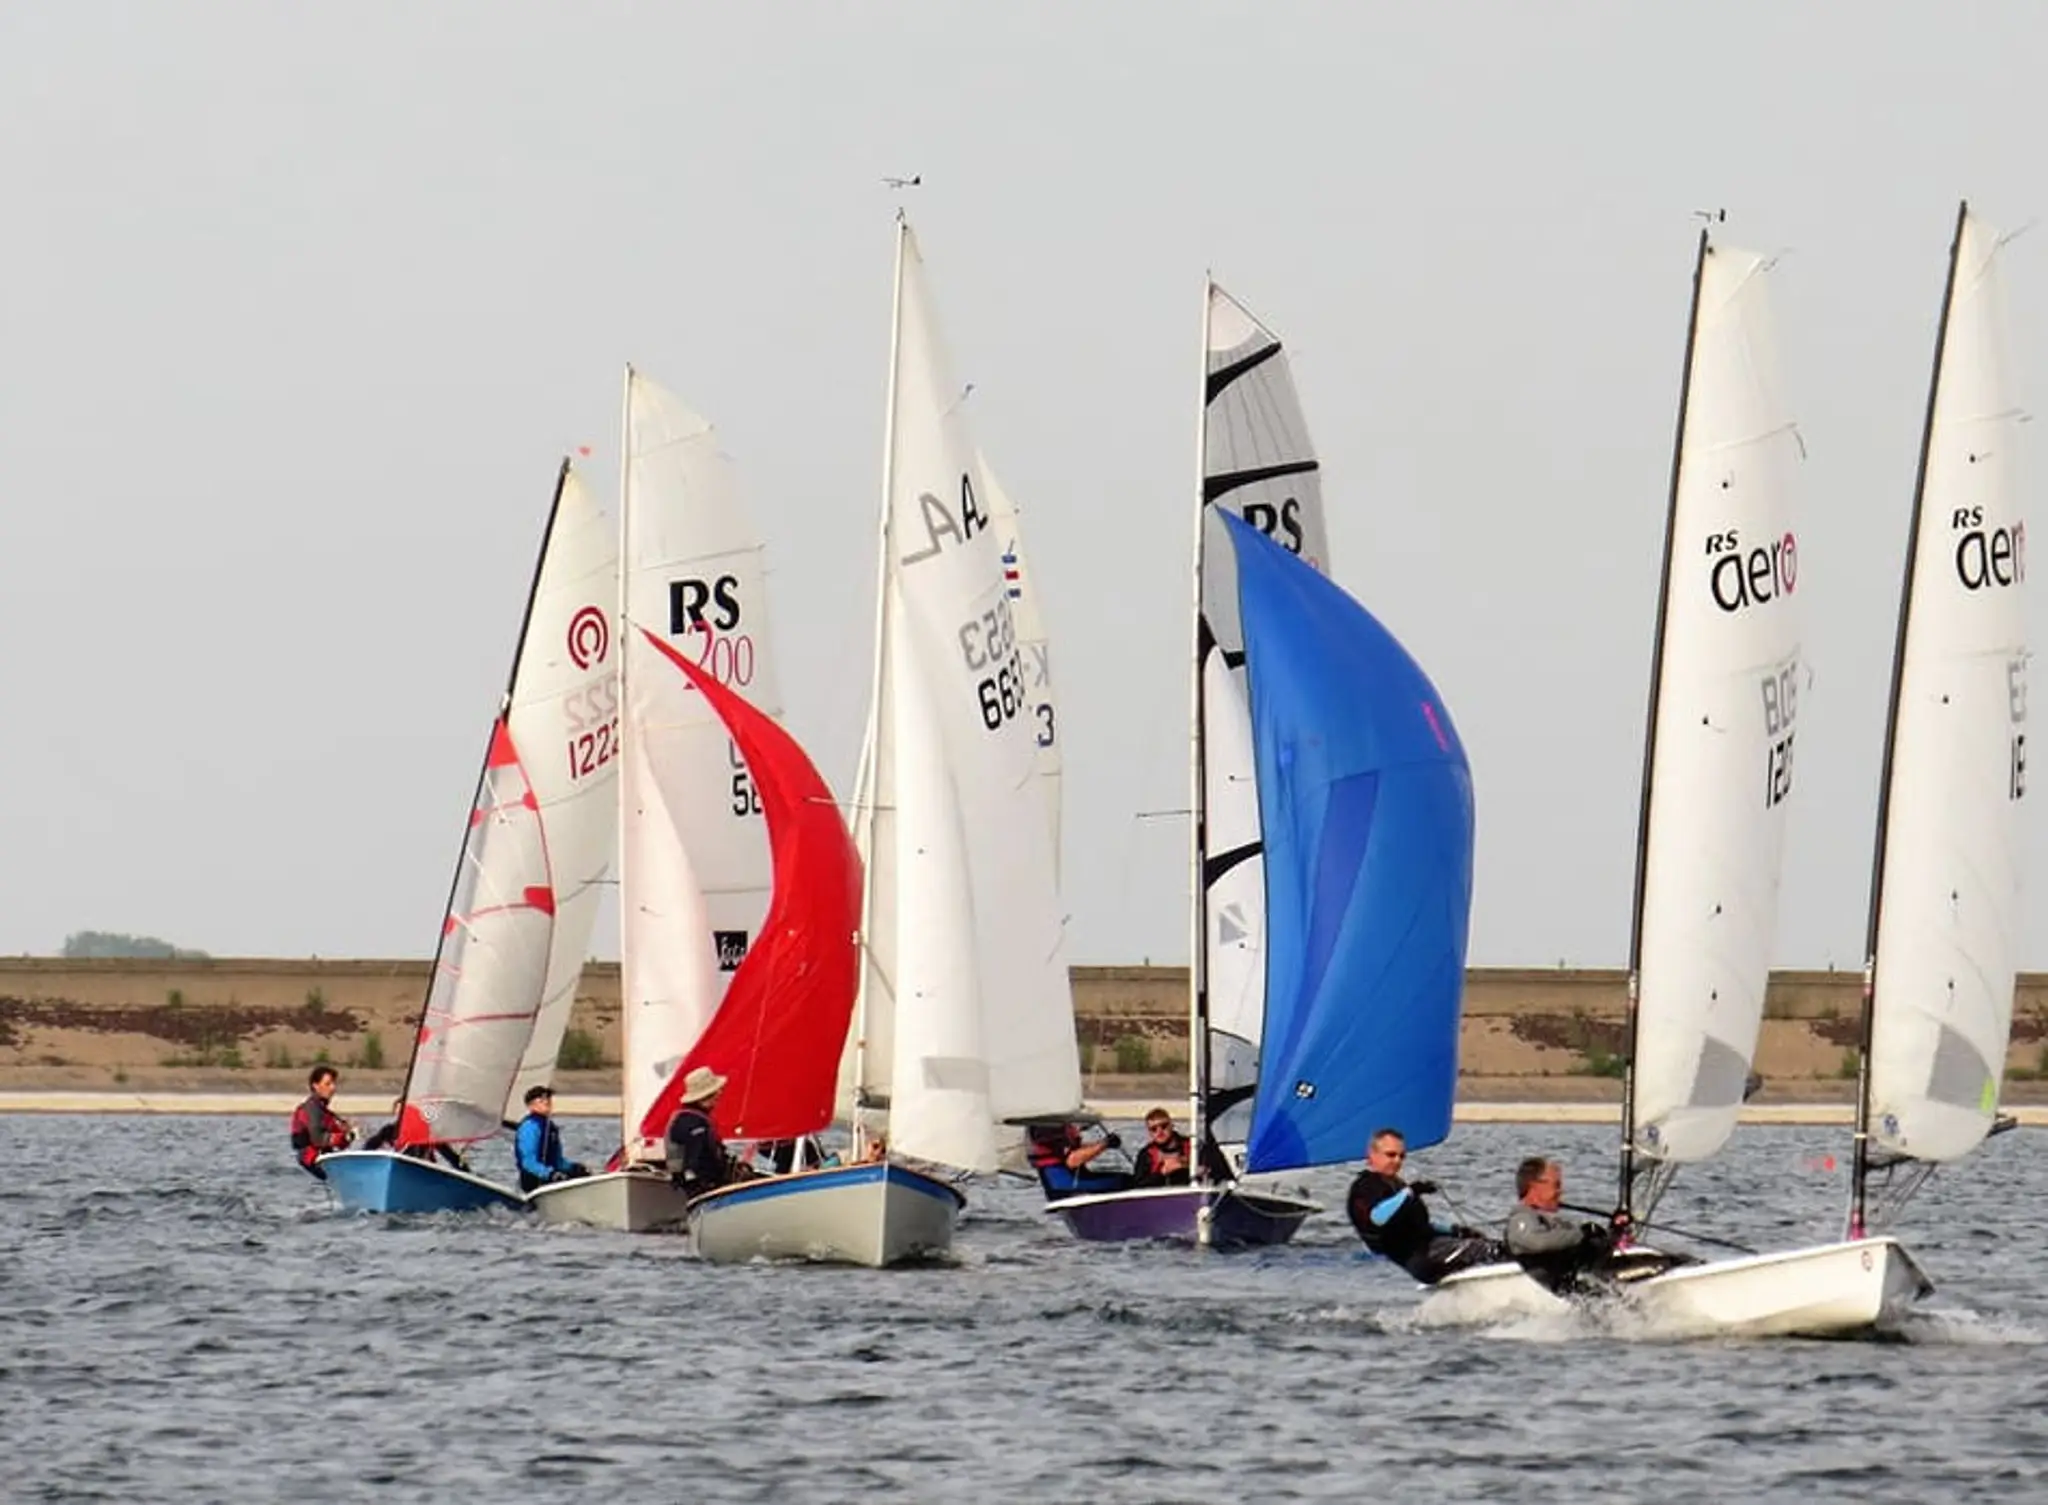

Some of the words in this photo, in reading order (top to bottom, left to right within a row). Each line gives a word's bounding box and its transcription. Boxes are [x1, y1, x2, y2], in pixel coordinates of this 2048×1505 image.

[1953, 506, 1983, 529] RS
[1706, 530, 1738, 554] RS
[1711, 532, 1797, 612] aero
[669, 576, 740, 634] RS
